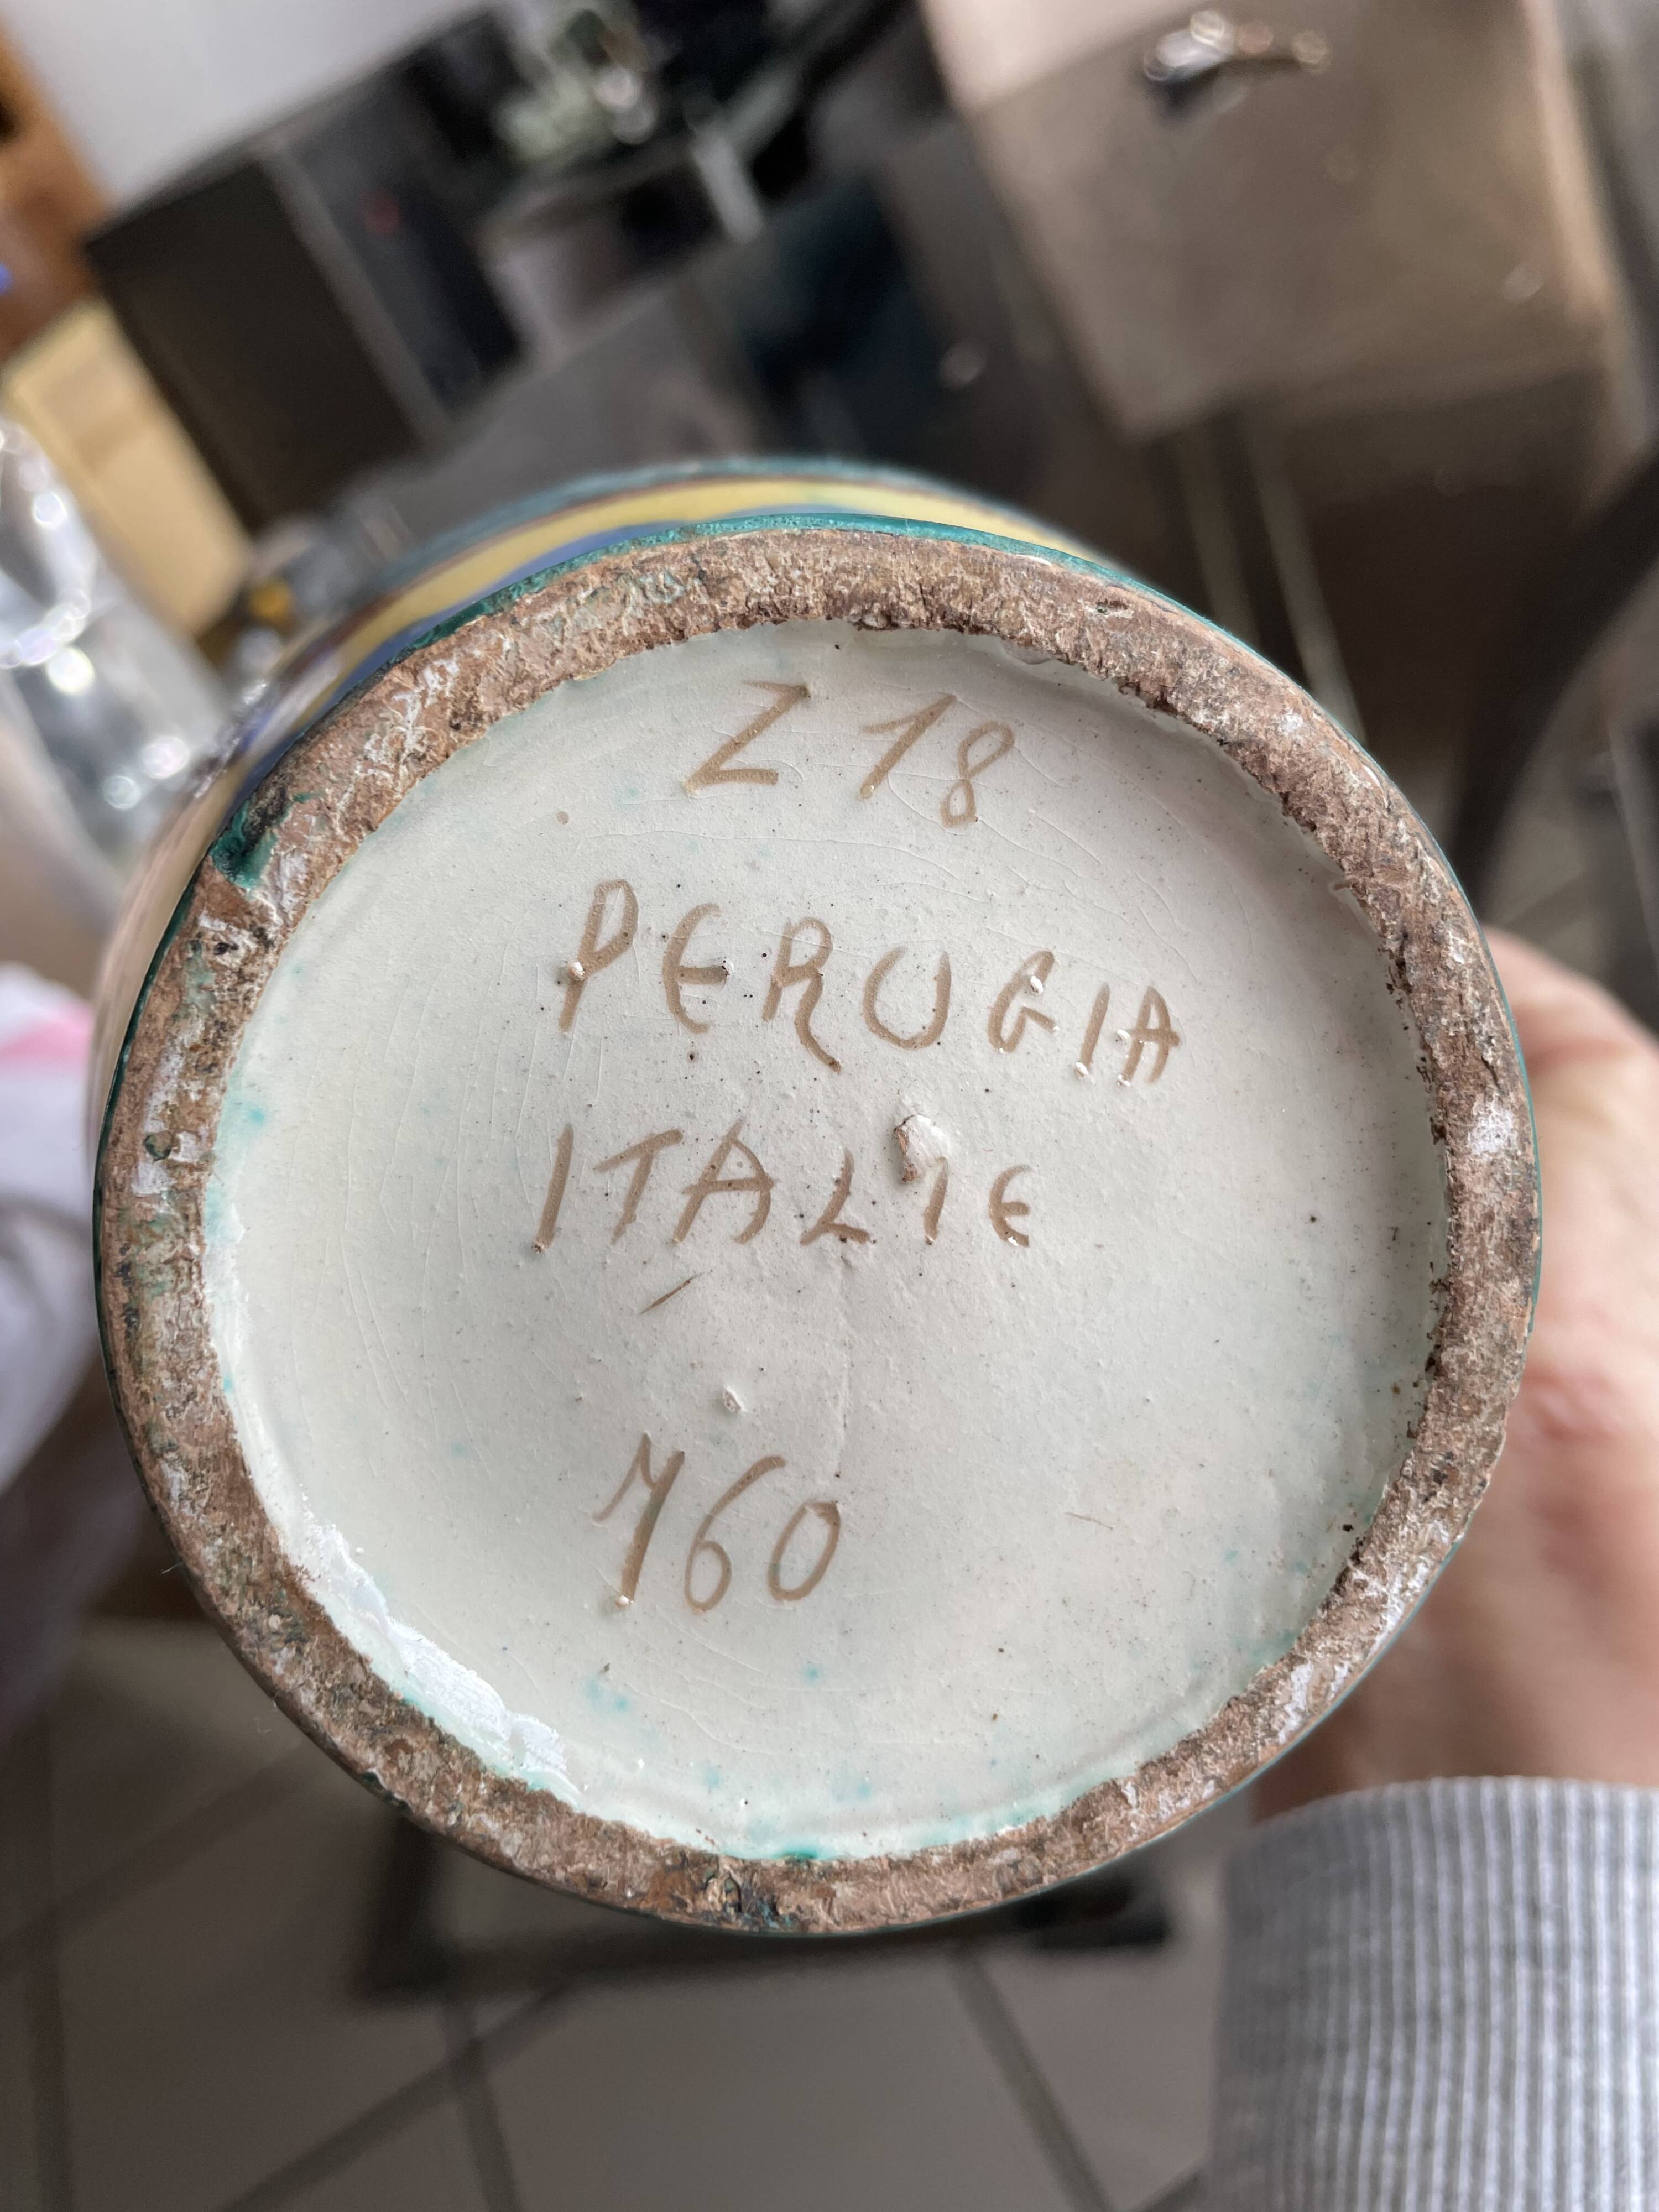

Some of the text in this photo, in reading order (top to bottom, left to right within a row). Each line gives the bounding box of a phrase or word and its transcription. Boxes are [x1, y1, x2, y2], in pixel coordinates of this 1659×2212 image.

[859, 695, 1015, 828] 18
[557, 878, 1181, 1087] PERUGIA
[532, 1119, 1031, 1253] ITALIE
